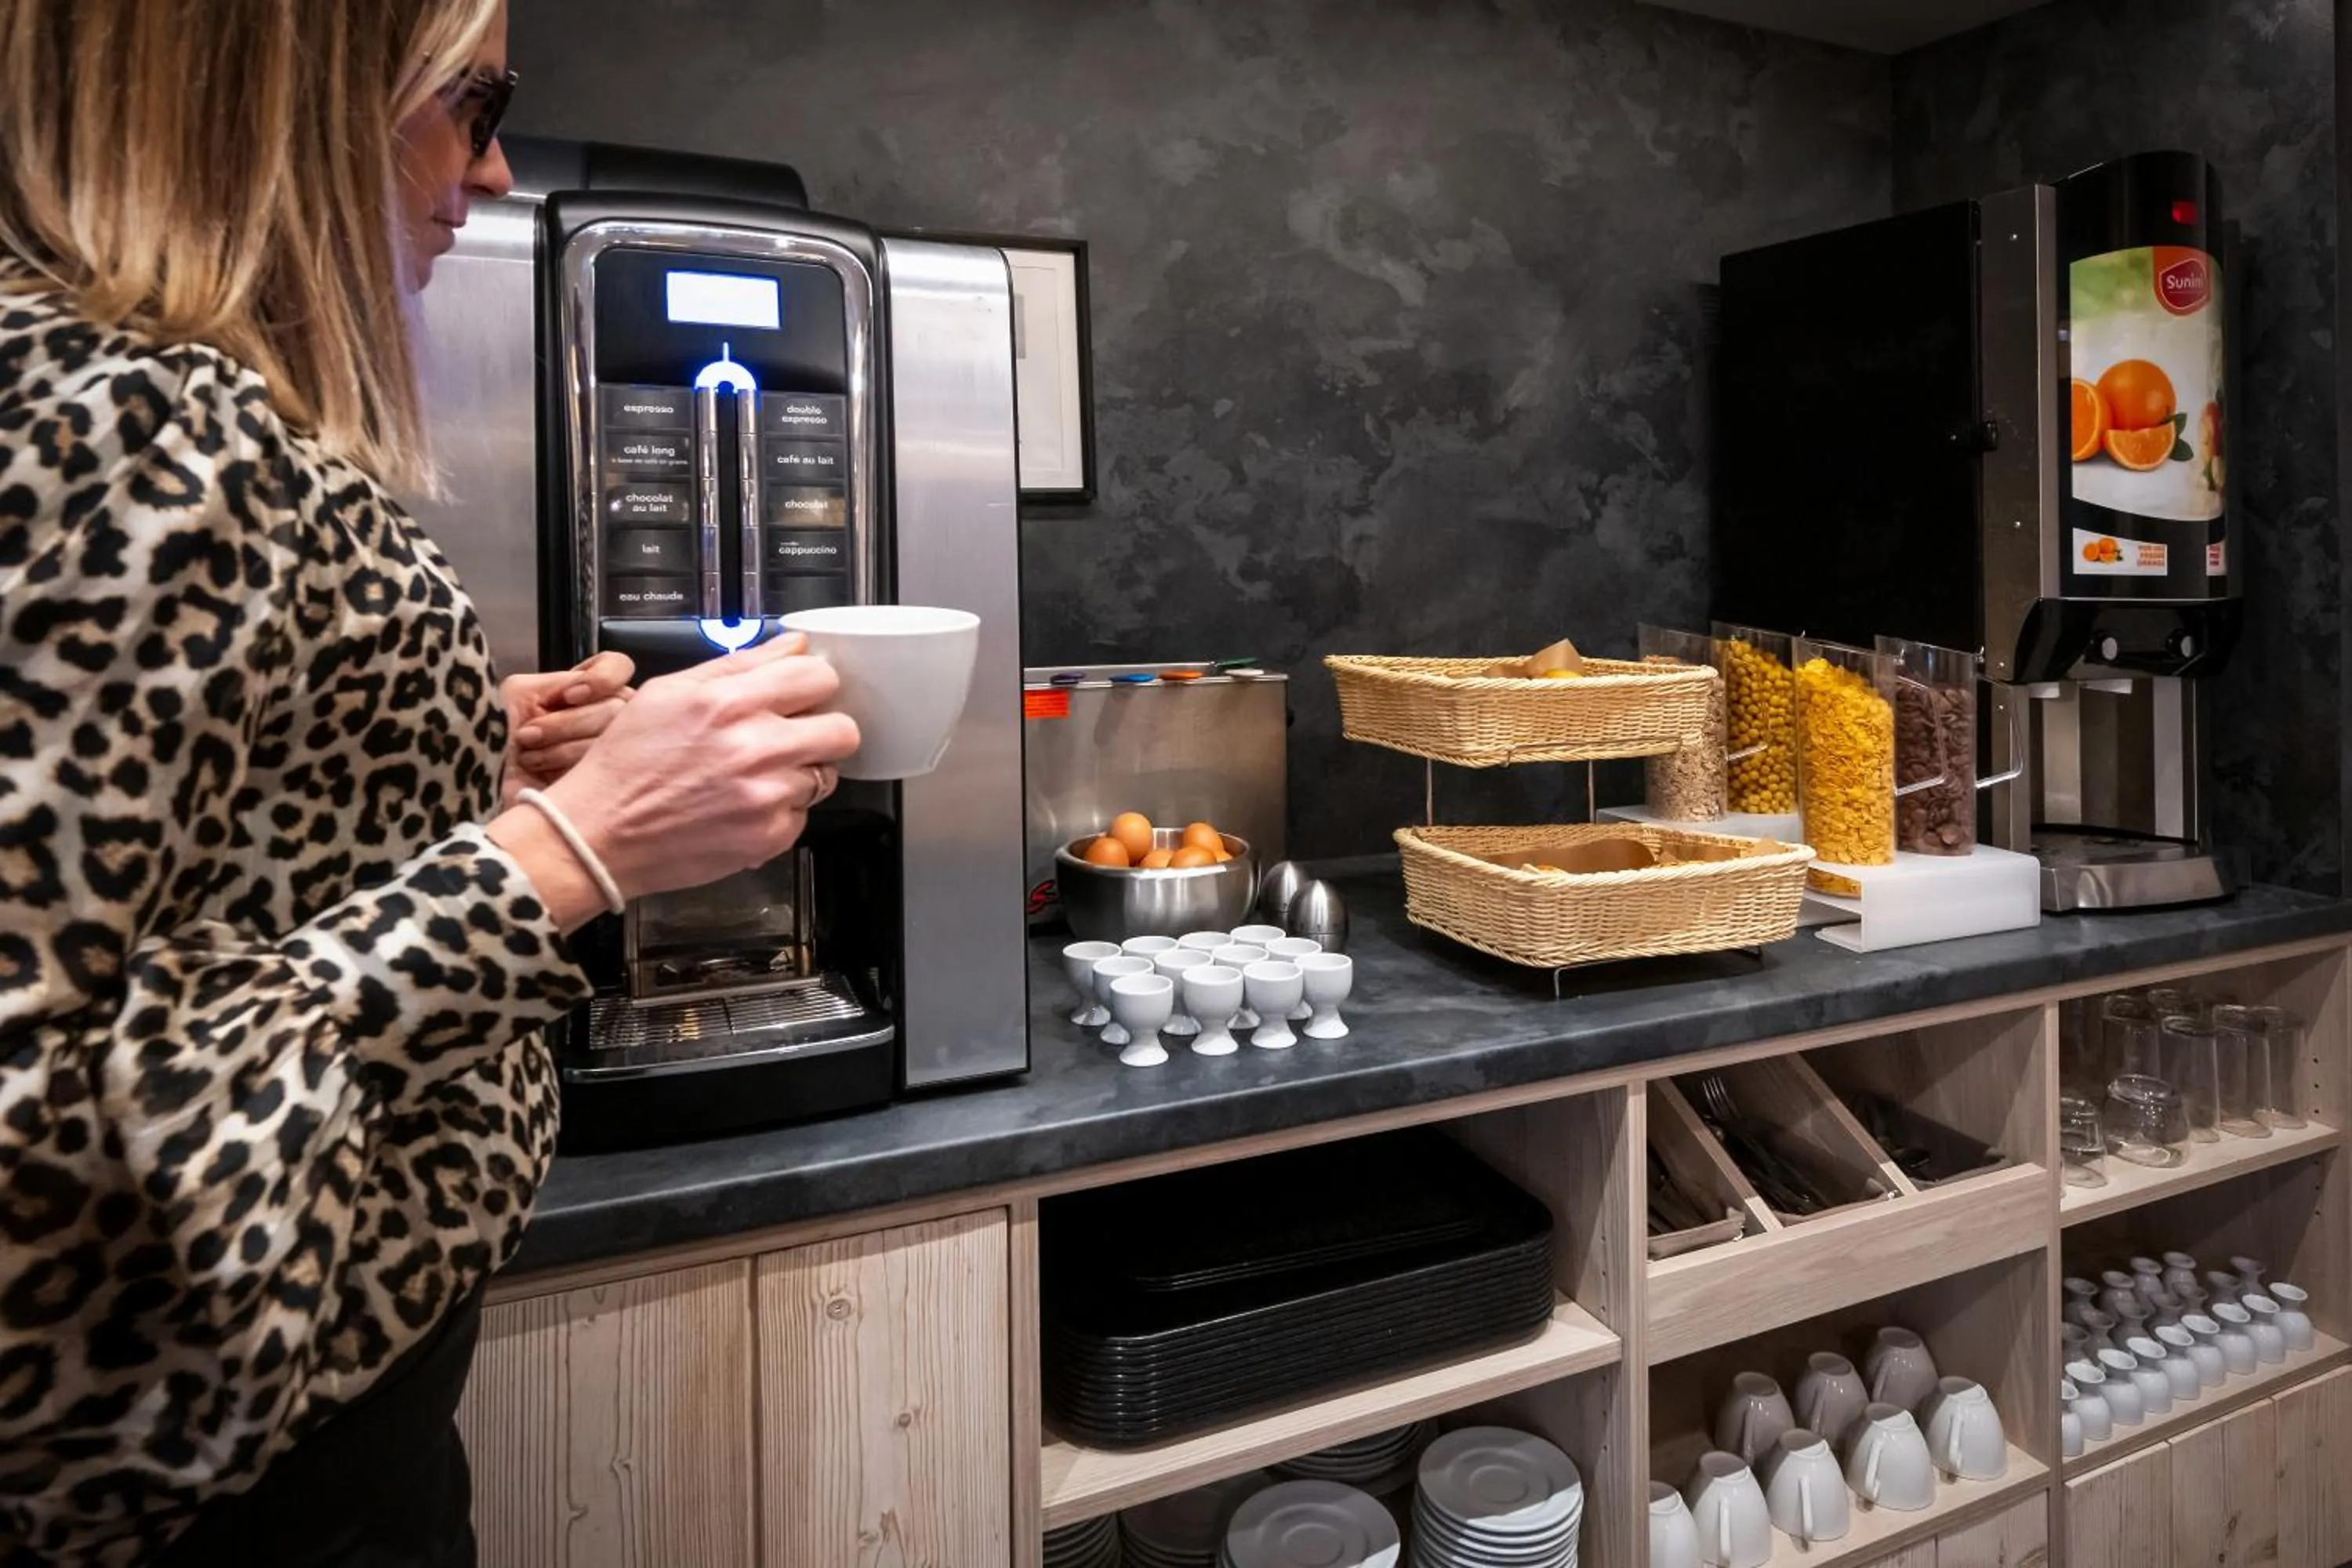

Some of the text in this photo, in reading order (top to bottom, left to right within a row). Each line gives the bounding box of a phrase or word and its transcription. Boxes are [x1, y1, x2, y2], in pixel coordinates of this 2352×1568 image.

[2166, 272, 2204, 289] Sunini
[786, 405, 822, 415] double
[623, 445, 675, 457] café long
[818, 456, 833, 465] lait
[626, 493, 673, 503] chocolat
[649, 503, 668, 513] lait
[641, 543, 659, 554] lait
[643, 590, 684, 601] chaude
